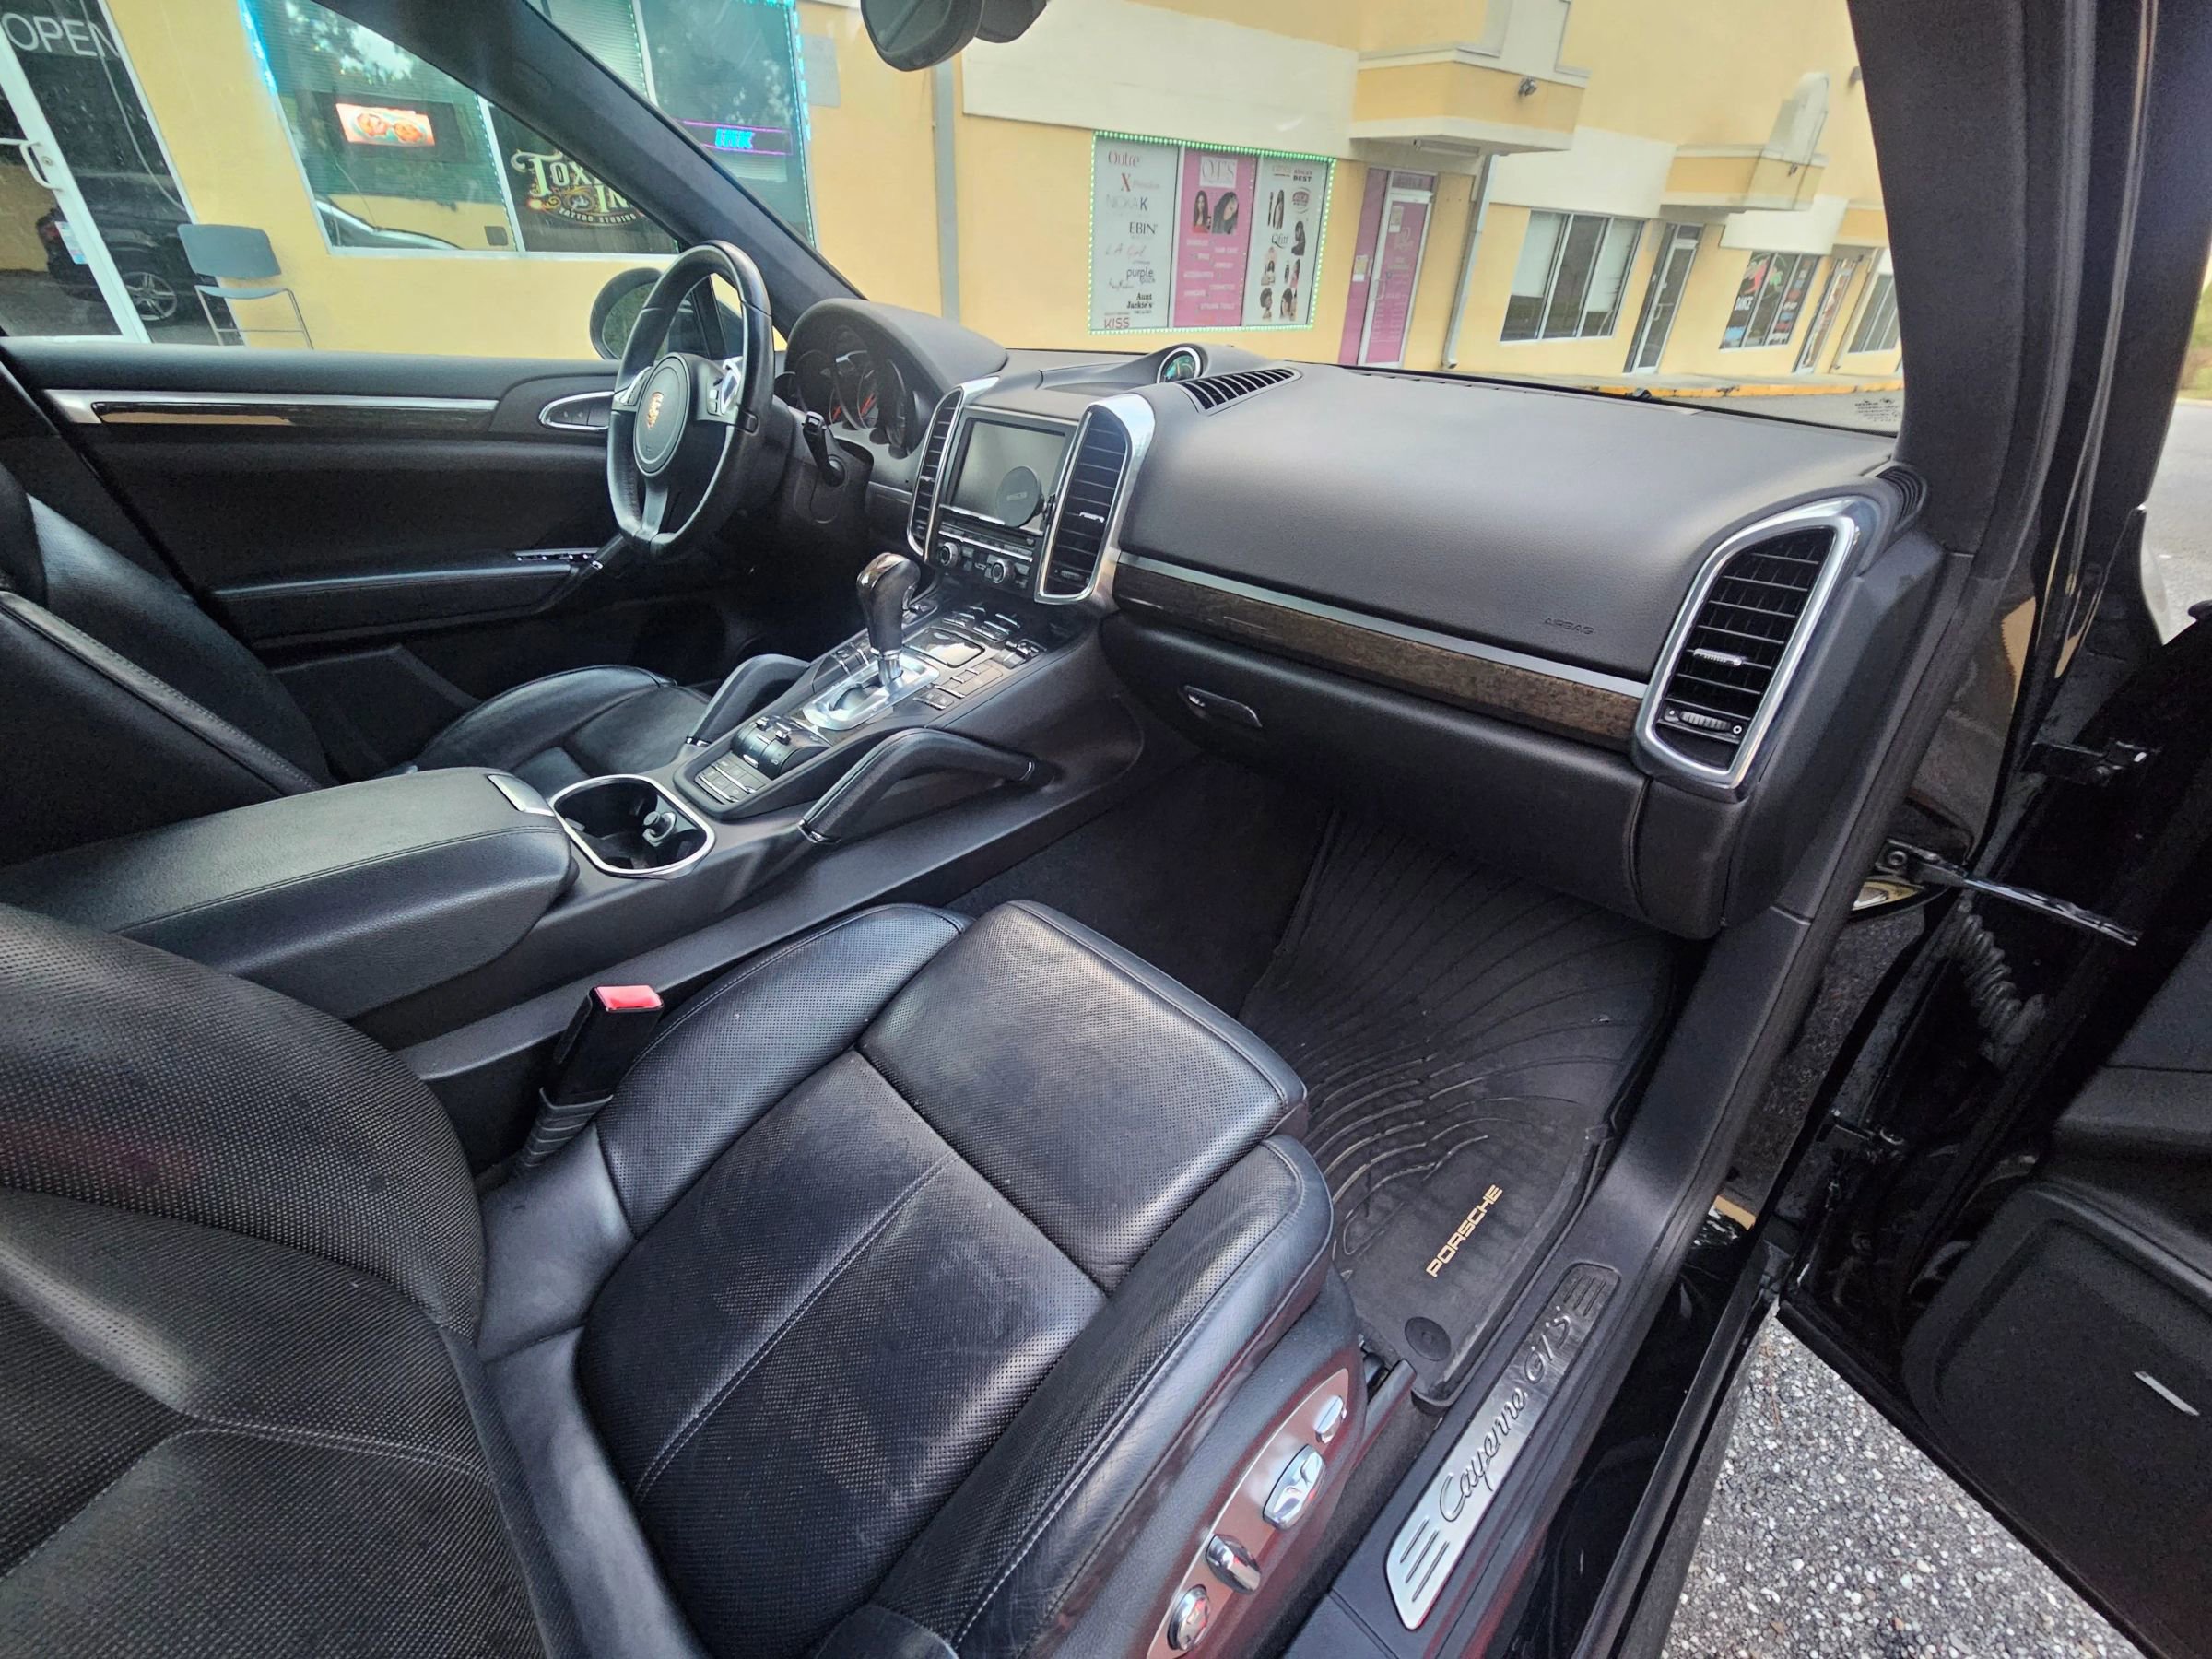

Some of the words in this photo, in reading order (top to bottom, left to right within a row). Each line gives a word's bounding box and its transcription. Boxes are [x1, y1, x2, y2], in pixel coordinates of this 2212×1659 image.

[2, 12, 120, 58] OPEN
[511, 148, 604, 196] TOX
[594, 184, 630, 213] IN
[559, 207, 594, 222] TATTOO
[599, 213, 637, 223] STUDIOS
[1130, 222, 1156, 235] EBIN
[1126, 266, 1154, 280] purple
[1136, 292, 1152, 301] Aunt
[1126, 301, 1153, 310] Jackie's
[1104, 317, 1130, 329] KISS
[1425, 1184, 1503, 1278] PORSCHE
[1440, 1387, 1528, 1523] Cayenne
[1524, 1306, 1571, 1385] GTS
